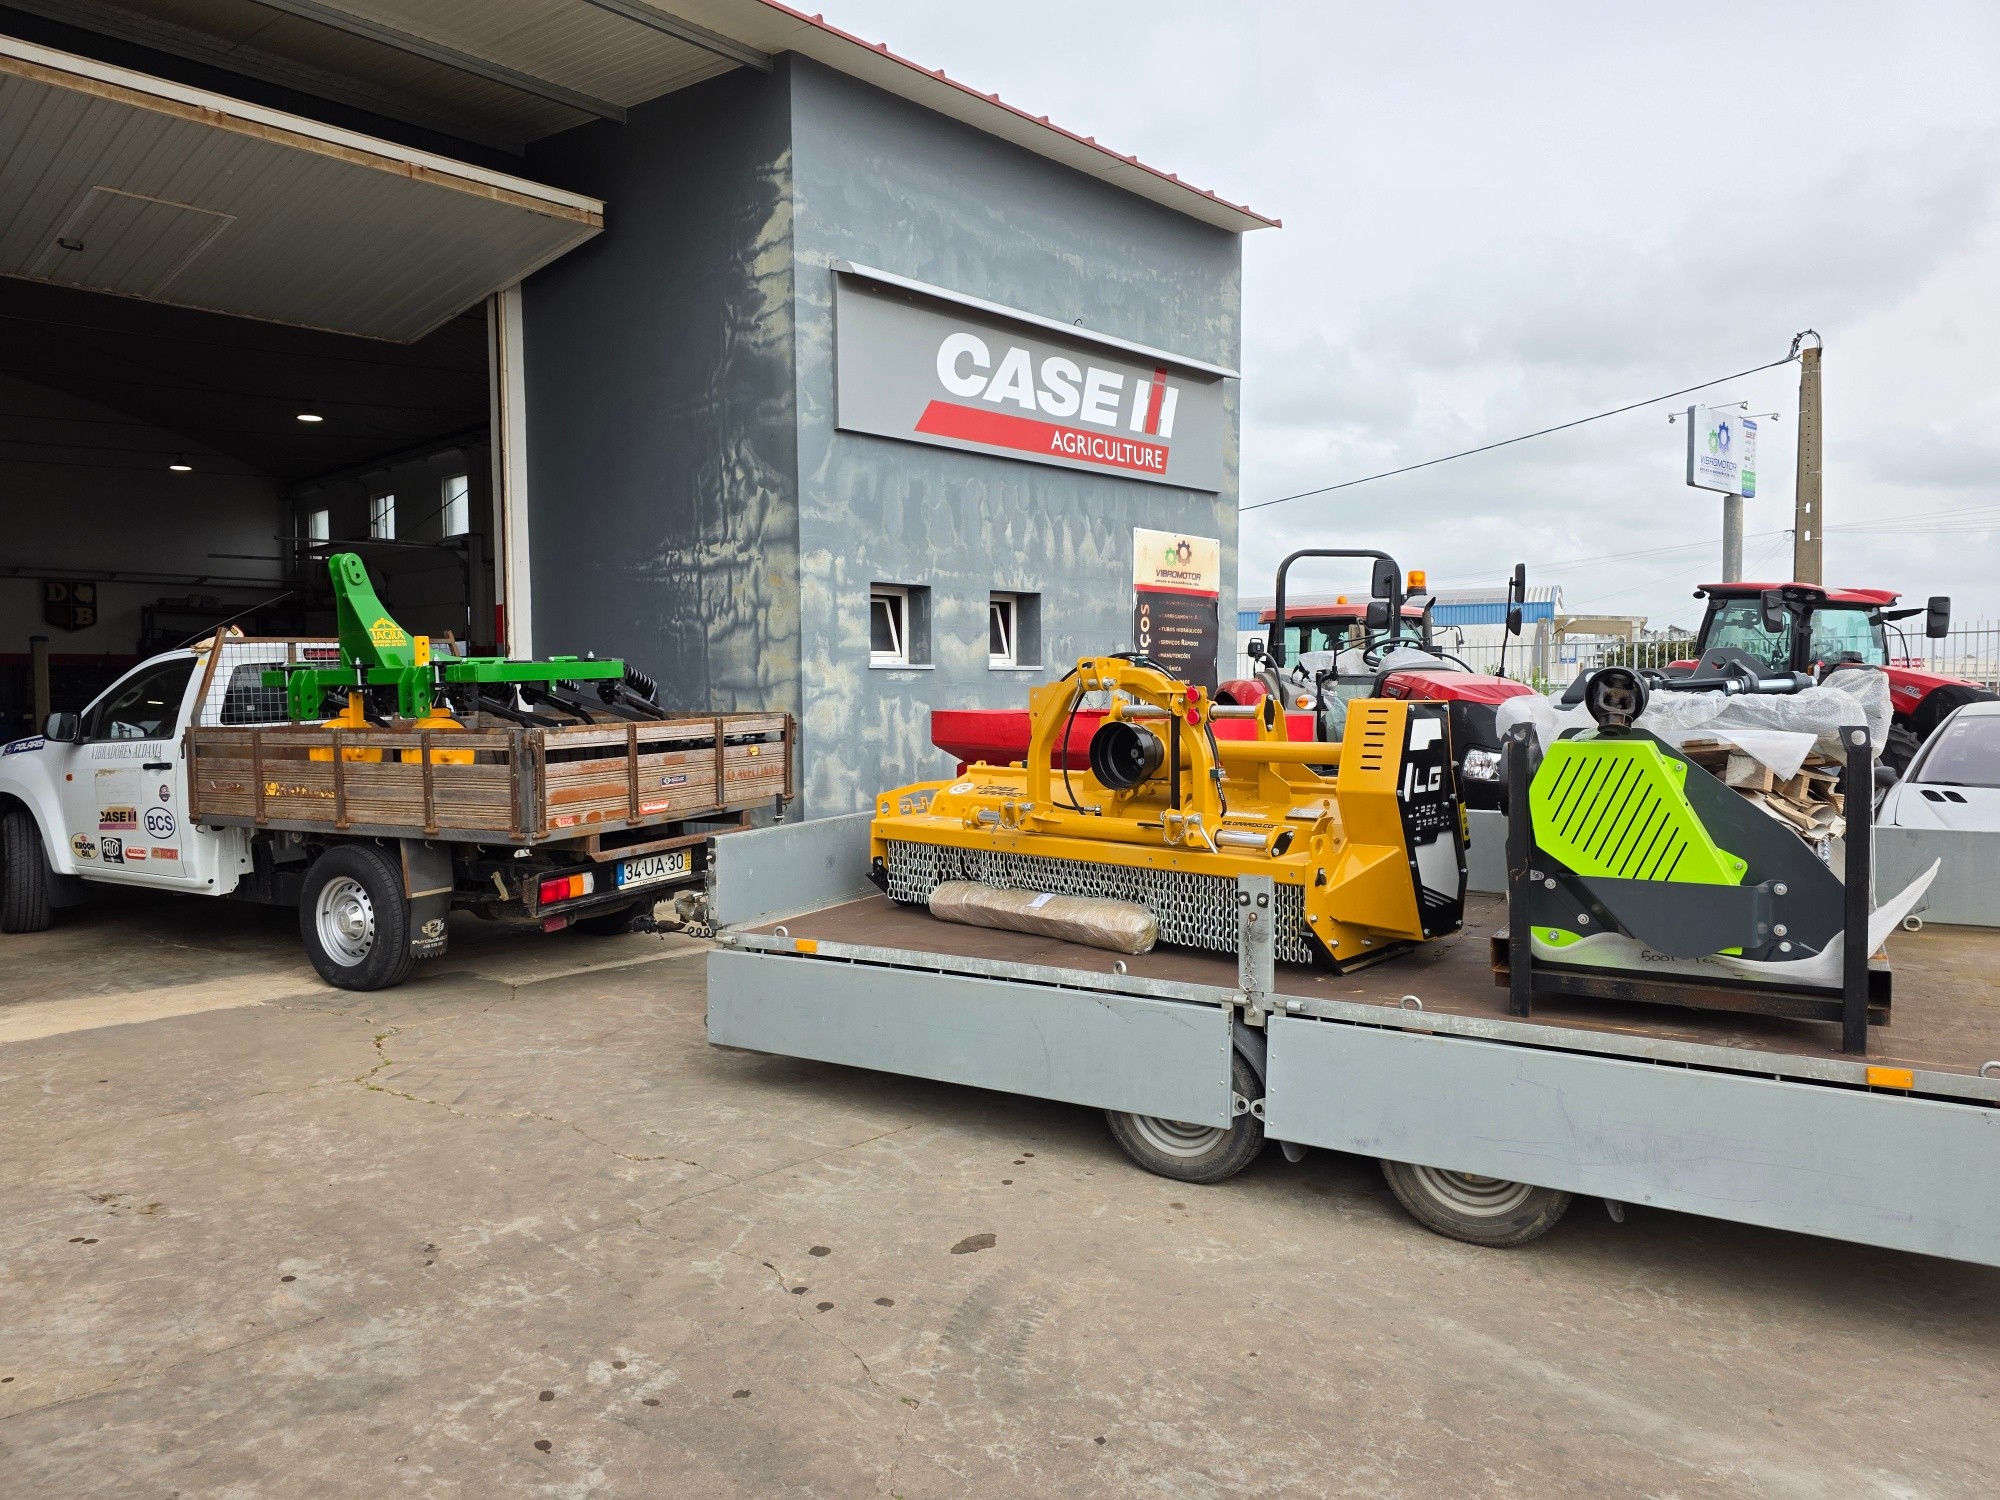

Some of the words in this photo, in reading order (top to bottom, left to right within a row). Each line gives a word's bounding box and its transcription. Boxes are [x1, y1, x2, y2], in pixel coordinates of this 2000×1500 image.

[936, 332, 1125, 428] CASE
[1051, 430, 1163, 469] AGRICULTURE
[1156, 569, 1201, 581] VIBROMOTOR
[14, 739, 45, 752] POLARIS
[91, 744, 132, 760] VIBRADORES
[147, 815, 173, 831] BCS
[81, 849, 92, 858] OIL
[102, 838, 120, 858] FELCO
